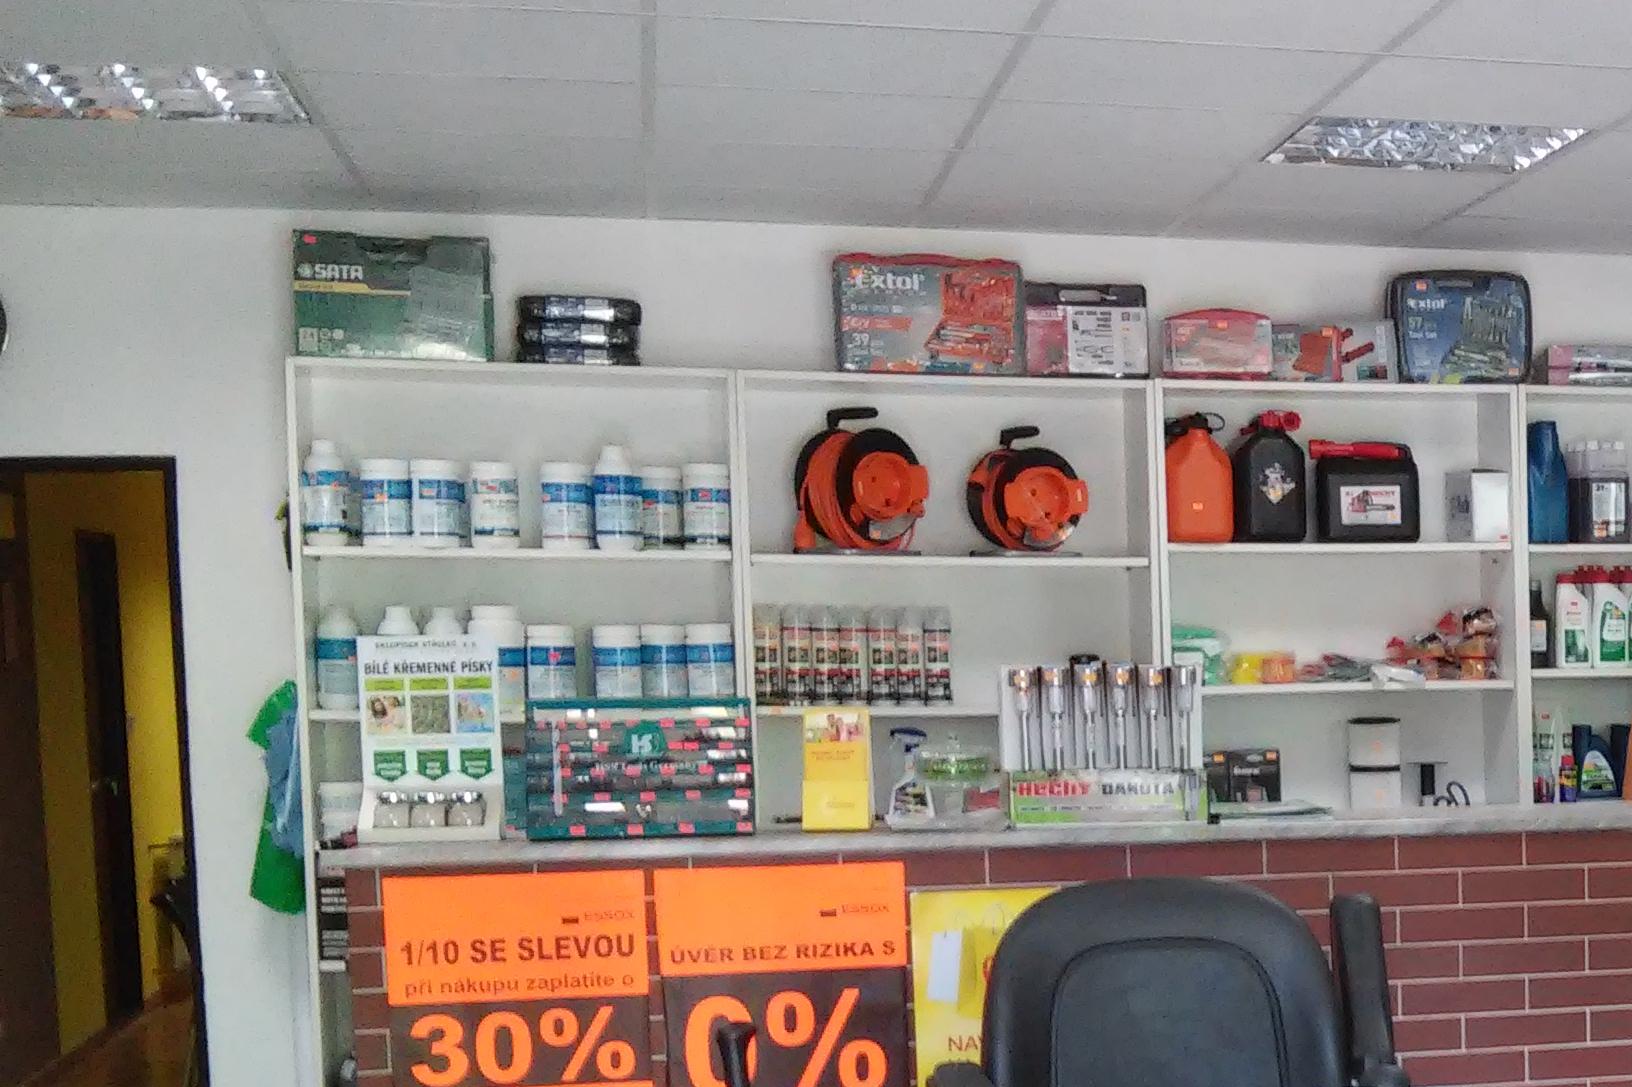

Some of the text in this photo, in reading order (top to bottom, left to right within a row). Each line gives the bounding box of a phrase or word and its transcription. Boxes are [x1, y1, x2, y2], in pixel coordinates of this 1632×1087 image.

[314, 263, 364, 280] SATA
[364, 658, 493, 675] BÍLÉ KŘEMENNÉ PÍSKY
[401, 933, 635, 966] 1/10 SE SLEVOU
[743, 945, 788, 961] BEZ
[796, 942, 875, 959] RIZIKA
[882, 940, 896, 956] S
[440, 977, 518, 996] nákupu
[622, 974, 634, 985] o
[410, 1005, 637, 1087] 30%
